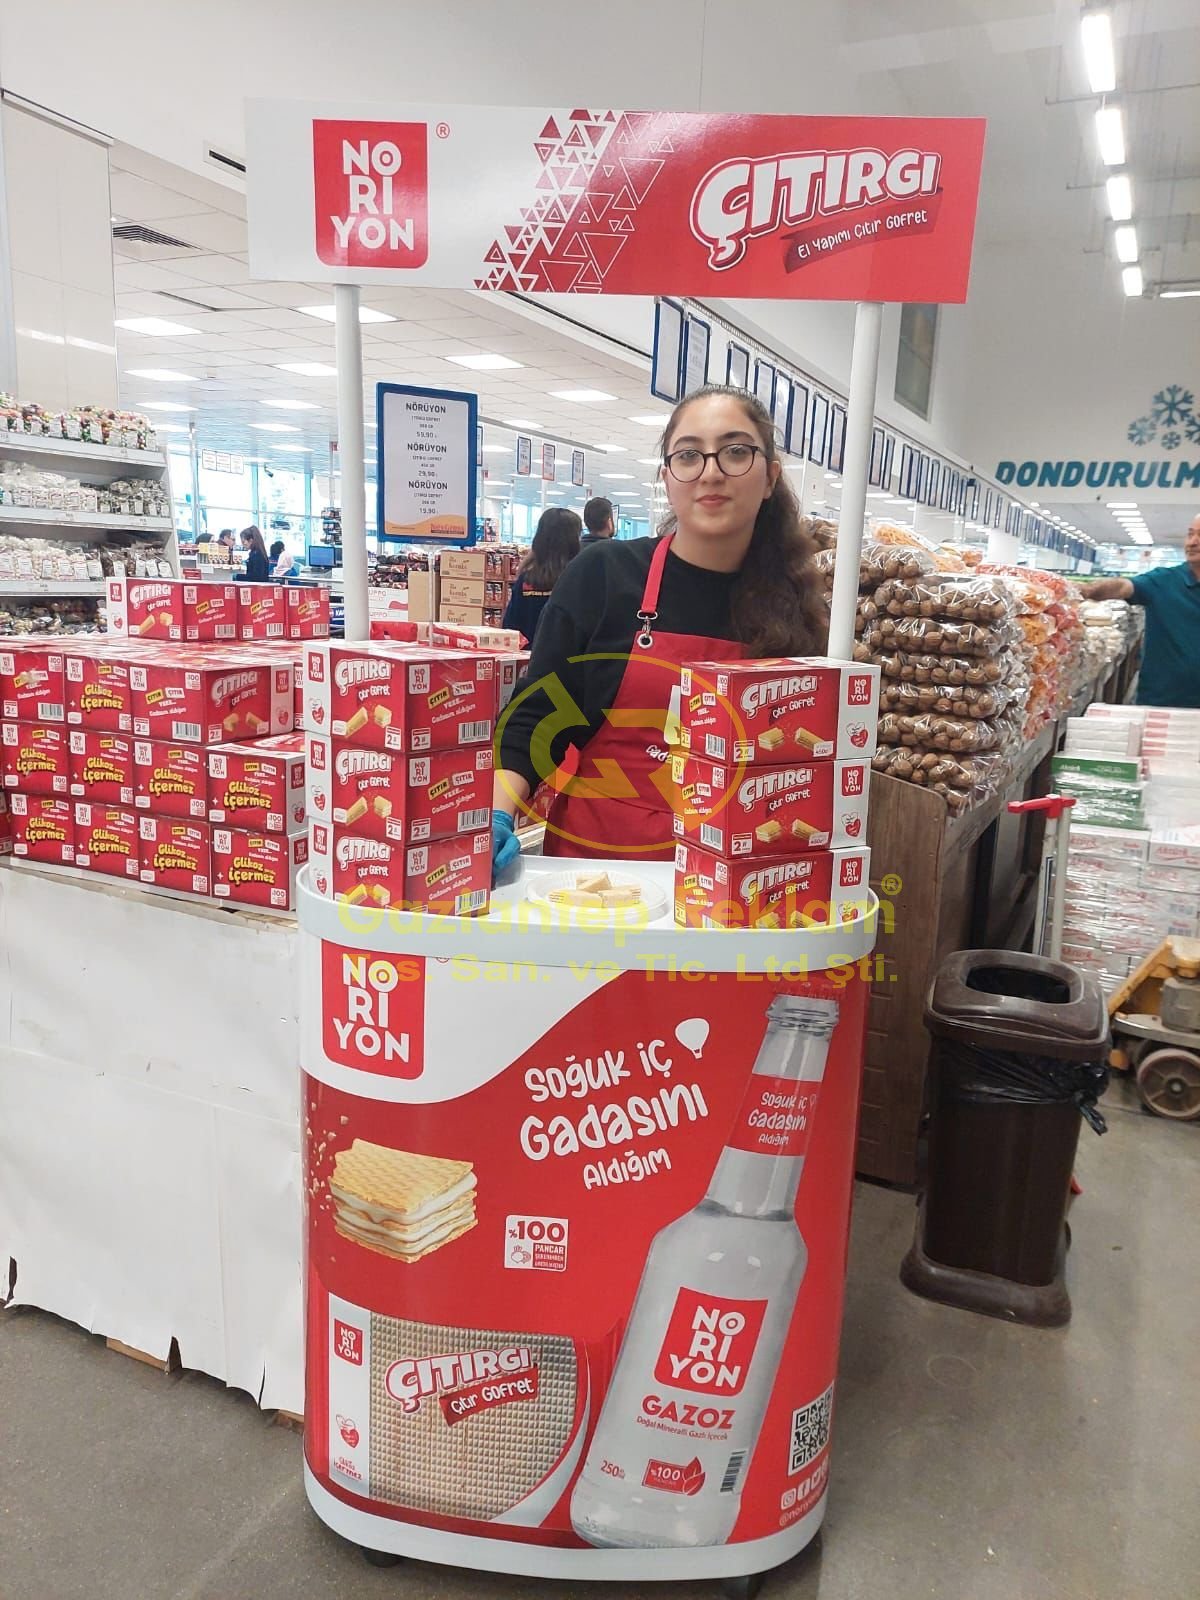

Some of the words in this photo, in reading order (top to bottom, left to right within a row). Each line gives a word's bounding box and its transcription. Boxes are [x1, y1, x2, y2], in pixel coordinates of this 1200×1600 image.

[343, 140, 401, 175] NO
[350, 175, 393, 214] RI
[693, 149, 941, 268] ÇITIRGI
[330, 216, 414, 250] YON
[798, 244, 811, 259] El
[813, 229, 851, 252] Yapımı
[336, 660, 391, 694] ÇITIRGI
[854, 679, 867, 687] NO
[211, 671, 258, 707] ÇITIRGI
[741, 675, 818, 719] ÇITIRGI
[850, 694, 868, 702] YON
[855, 687, 865, 695] RI
[80, 695, 123, 713] içermez
[16, 759, 57, 776] içermez
[83, 767, 124, 785] içermez
[336, 750, 391, 784] ÇITIRGI
[149, 779, 194, 797] içermez
[228, 781, 260, 795] Glikoz
[738, 768, 813, 811] ÇITIRGI
[848, 776, 858, 785] RI
[223, 792, 271, 811] içermez
[25, 828, 65, 844] içermez
[88, 839, 130, 856] içermez
[337, 837, 391, 870] ÇITIRGI
[153, 854, 197, 871] içermez
[233, 857, 263, 871] Glikoz
[845, 860, 857, 868] NO
[846, 868, 856, 876] RI
[228, 867, 275, 885] içermez
[740, 862, 812, 904] ÇITIRGI
[842, 875, 859, 883] YON
[342, 952, 398, 993] NO
[348, 985, 389, 1028] RI
[333, 1017, 410, 1063] YON
[636, 1039, 672, 1078] iç
[520, 1083, 709, 1161] Gadasını
[583, 1148, 672, 1190] Aldığım
[509, 1220, 565, 1242] %100
[692, 1305, 745, 1336] NO
[340, 1326, 356, 1341] NO
[341, 1336, 354, 1351] RI
[337, 1345, 359, 1361] YON
[689, 1330, 733, 1362] RI
[385, 1346, 531, 1415] ÇITIRGI
[669, 1353, 741, 1388] YON
[450, 1395, 477, 1415] Çıtır
[641, 1395, 736, 1429] GAZOZ
[600, 1459, 620, 1478] 250
